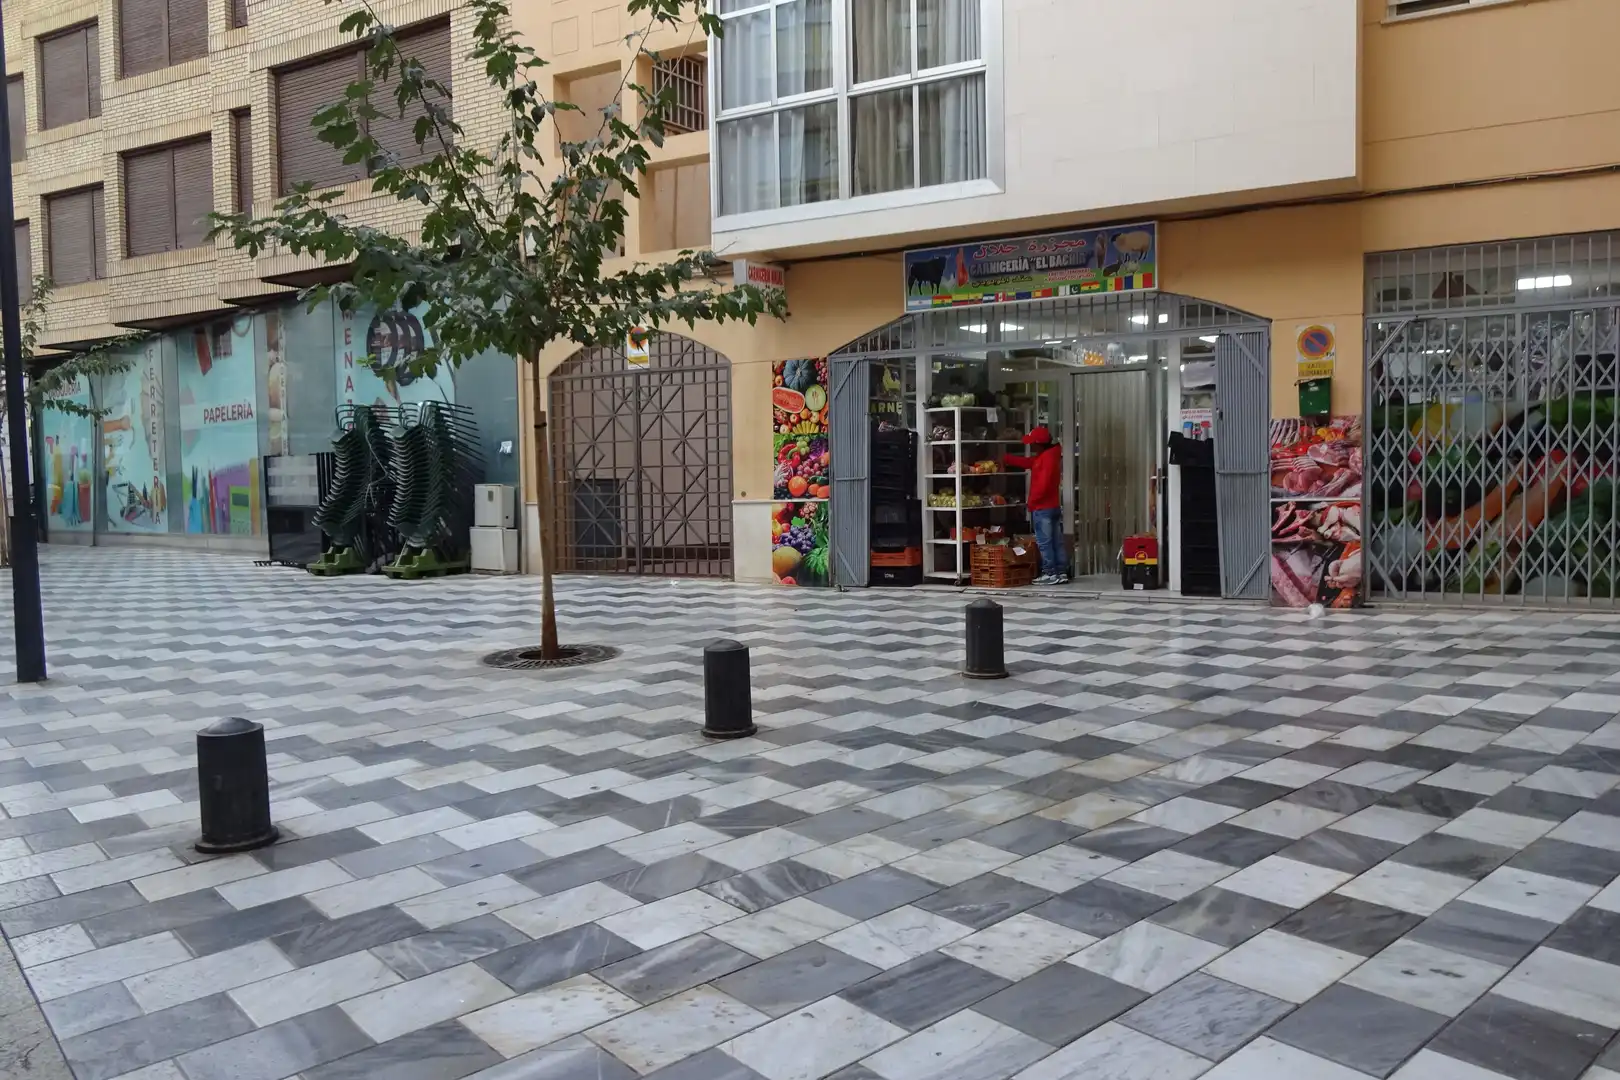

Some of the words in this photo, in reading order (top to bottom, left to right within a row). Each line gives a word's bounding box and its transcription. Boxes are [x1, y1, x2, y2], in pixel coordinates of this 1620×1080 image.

[973, 244, 1019, 259] حلال
[969, 256, 1029, 276] CARNICERÍA
[203, 400, 254, 424] PAPELERÍA
[870, 402, 903, 414] ARNE
